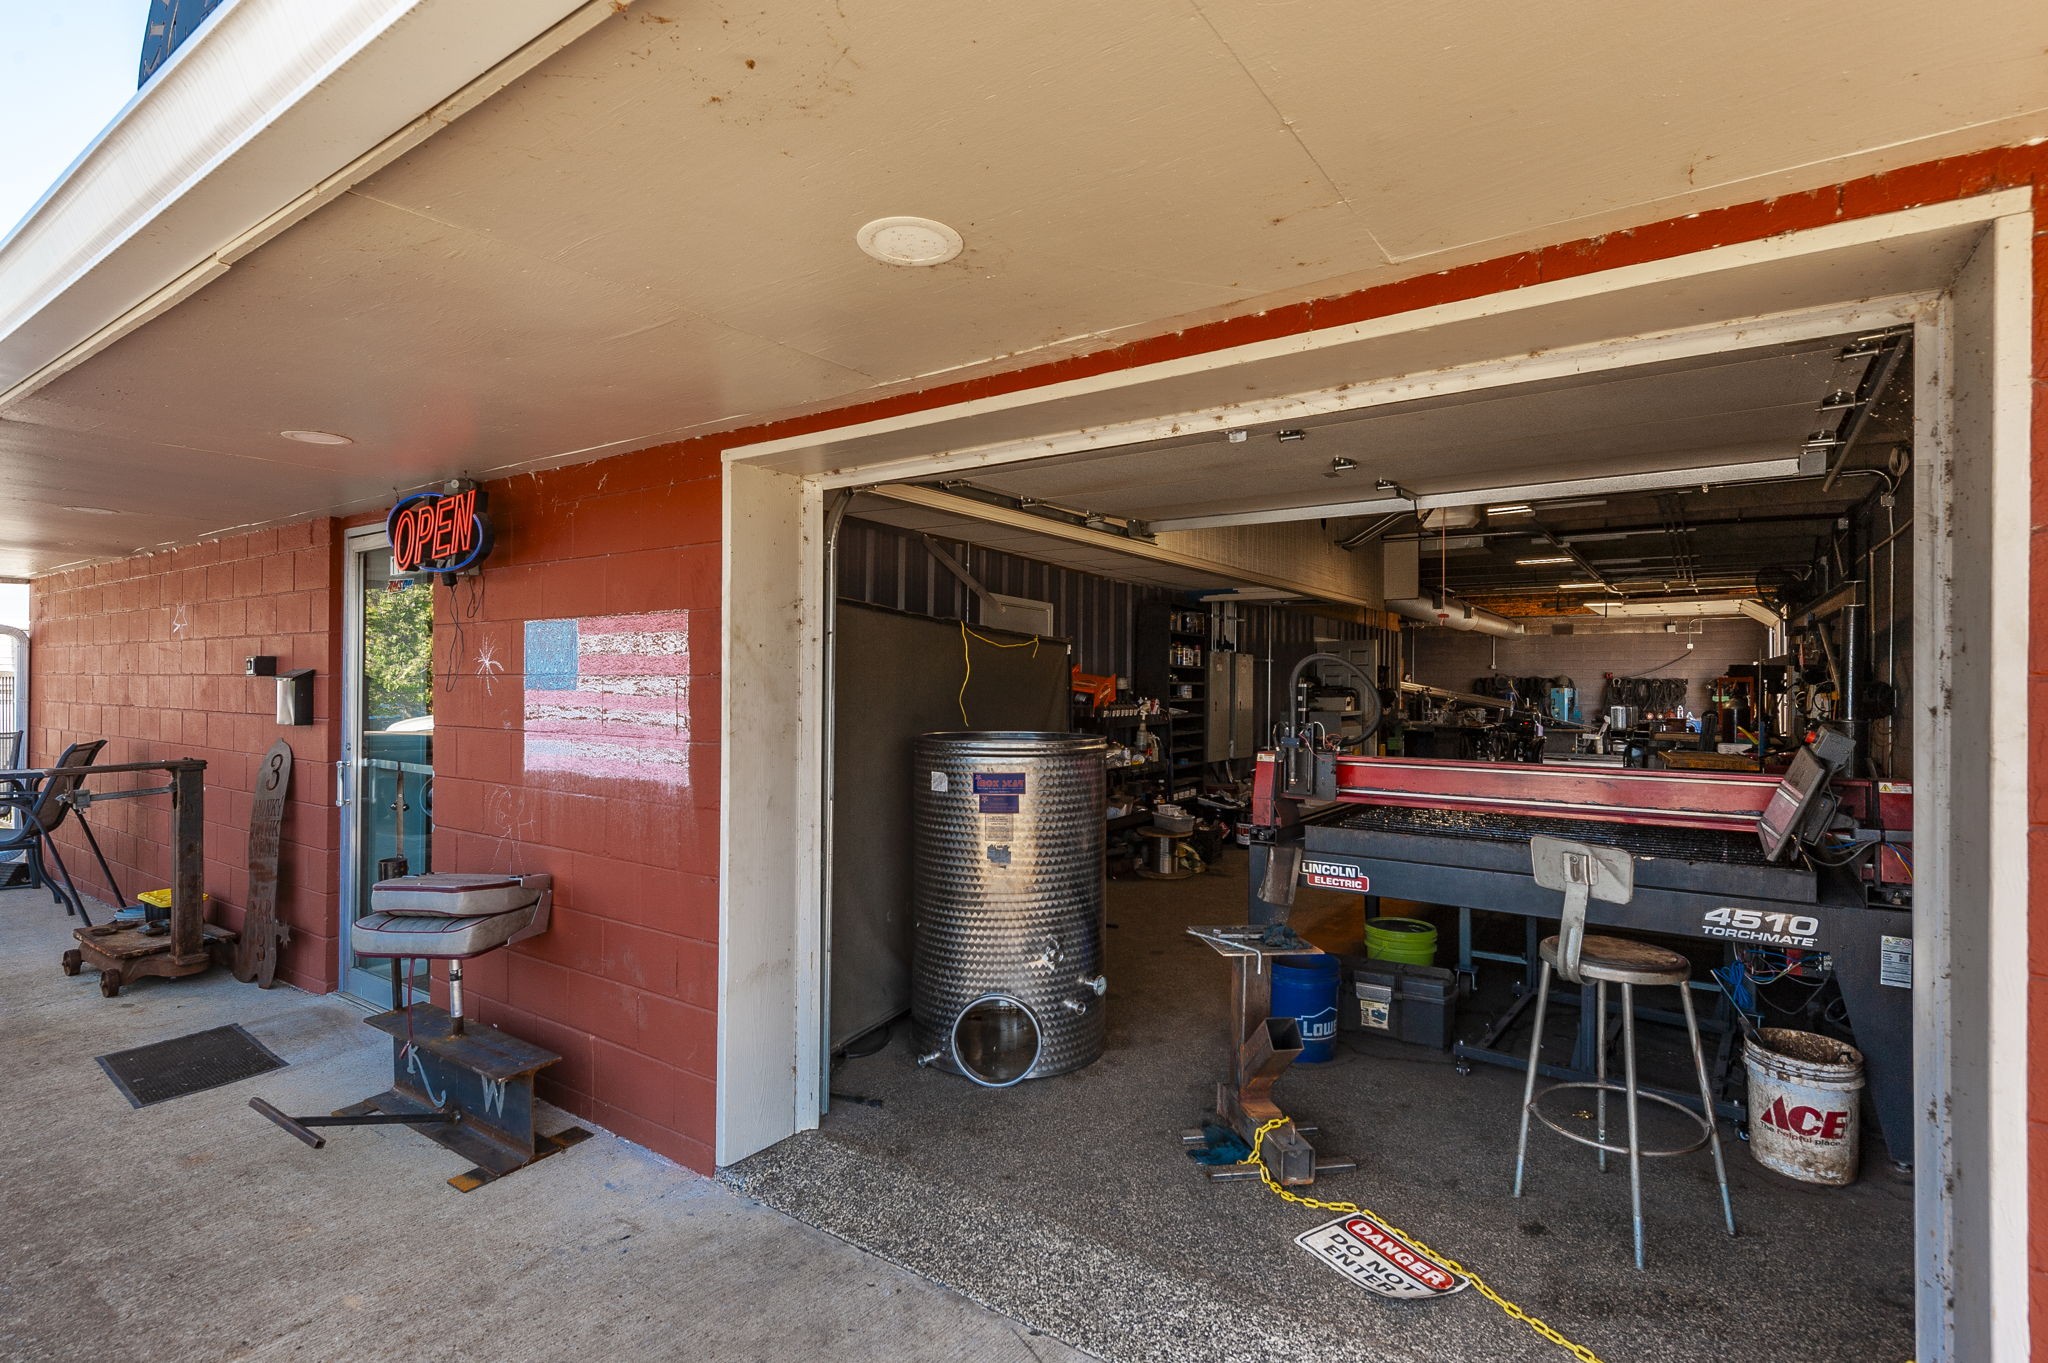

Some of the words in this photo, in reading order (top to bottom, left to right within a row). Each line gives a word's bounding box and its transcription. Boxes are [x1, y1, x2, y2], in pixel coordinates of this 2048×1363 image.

[394, 489, 476, 571] OPEN
[266, 753, 284, 791] 3
[1302, 862, 1356, 878] LINCOLN
[1314, 875, 1363, 889] ELECTRIC
[1702, 925, 1815, 948] TORCHMATE
[1704, 907, 1819, 936] 4510
[481, 1074, 505, 1119] W
[1761, 1095, 1848, 1140] ACE
[1323, 1244, 1397, 1293] ENTER
[1329, 1233, 1364, 1257] DO
[1366, 1260, 1421, 1292] NOT
[1351, 1222, 1447, 1286] DANGER
